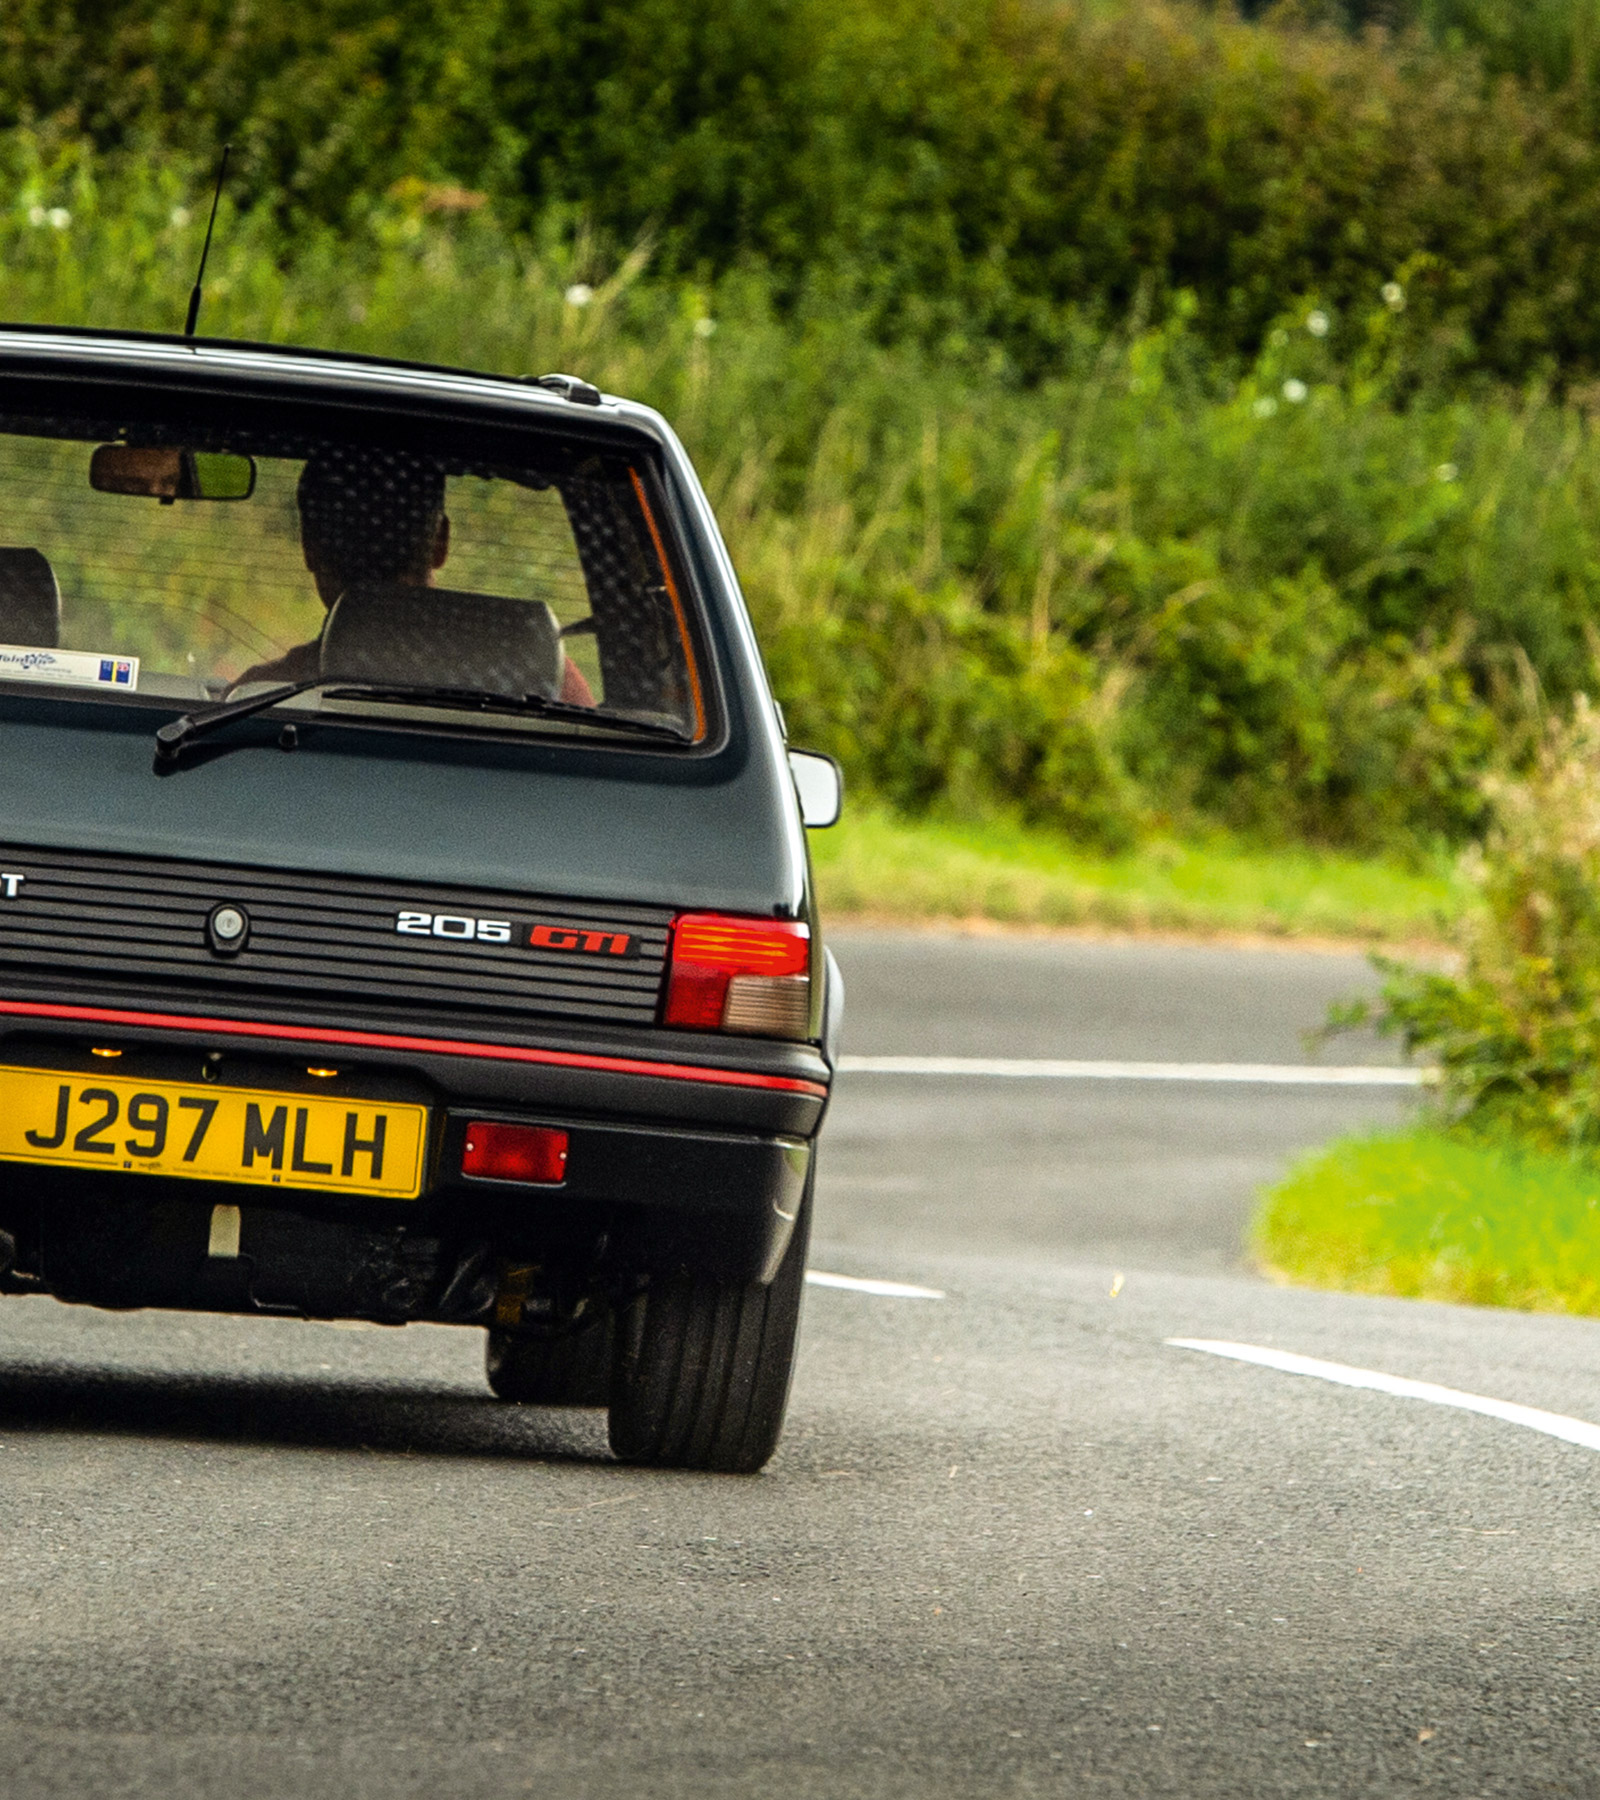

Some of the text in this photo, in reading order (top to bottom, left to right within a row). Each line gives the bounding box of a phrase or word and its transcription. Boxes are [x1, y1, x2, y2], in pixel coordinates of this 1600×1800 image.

[396, 911, 630, 954] 205 GTI
[24, 1084, 388, 1181] J297 MLH
